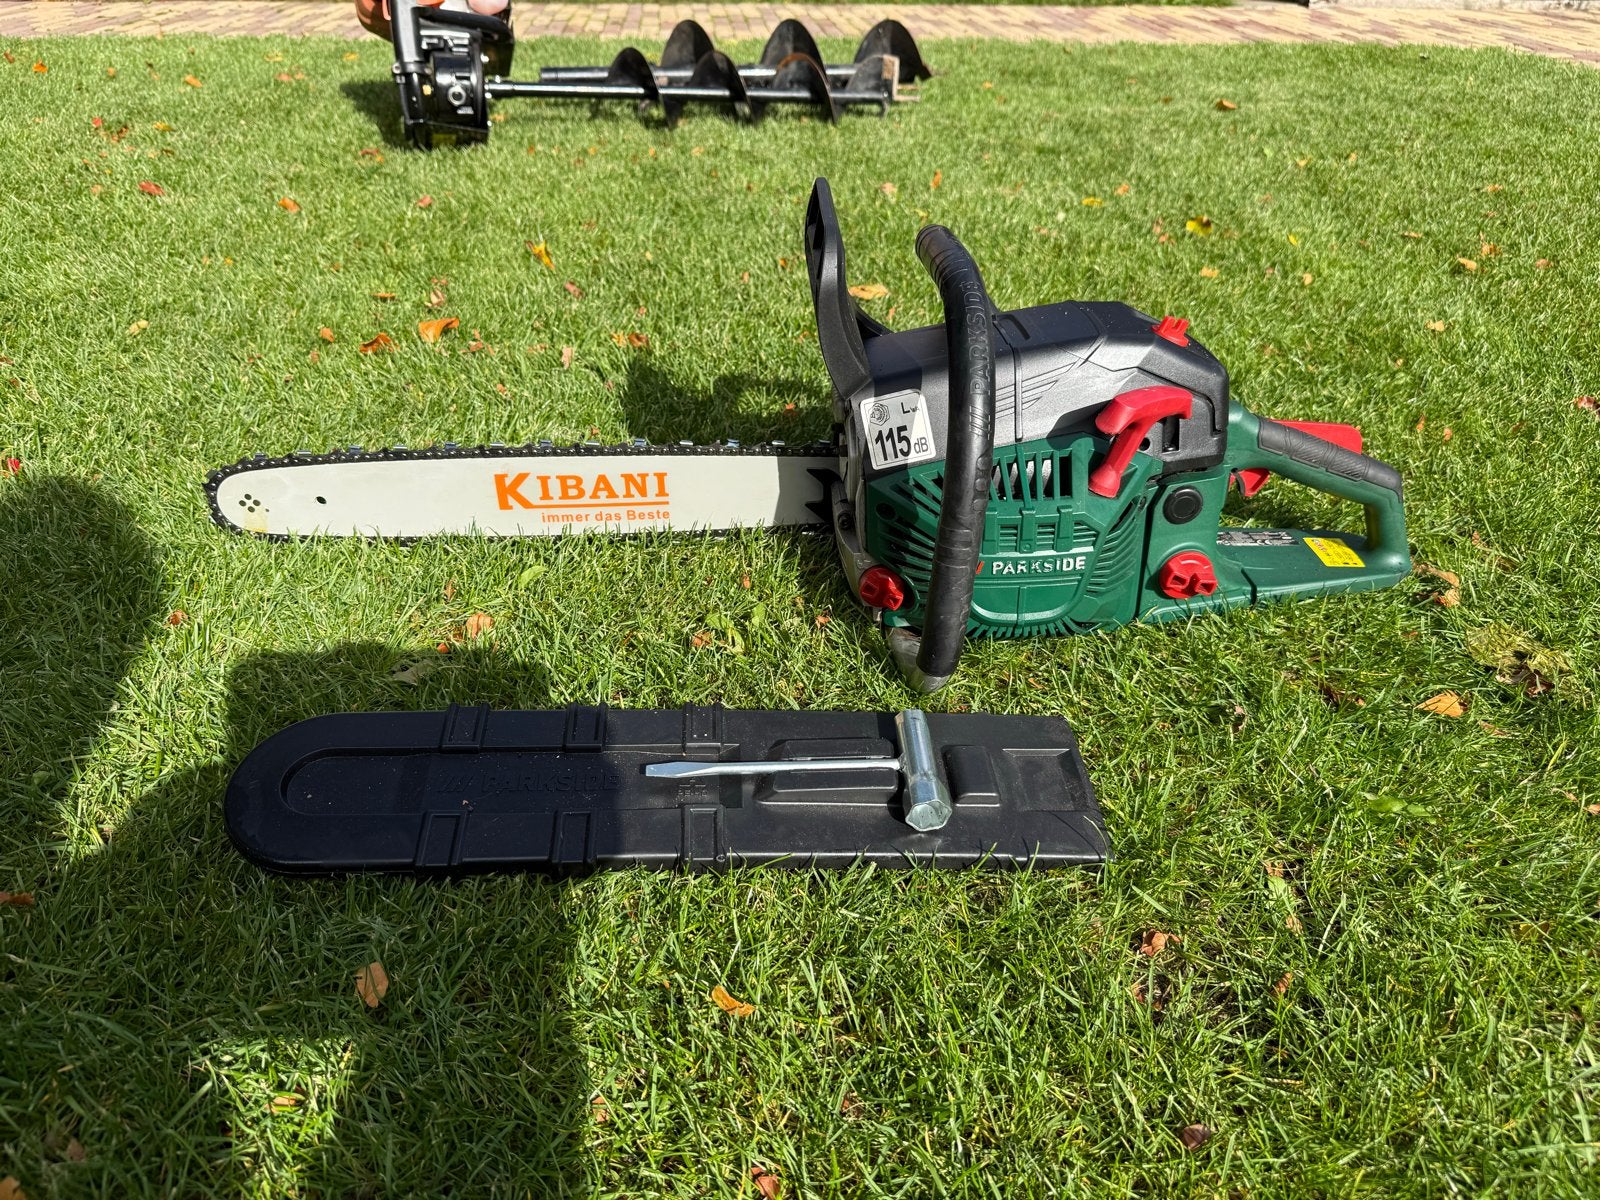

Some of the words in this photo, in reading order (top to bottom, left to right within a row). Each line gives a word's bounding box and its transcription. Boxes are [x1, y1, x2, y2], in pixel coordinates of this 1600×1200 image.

[875, 425, 911, 461] 115
[913, 436, 929, 454] dB
[494, 472, 670, 510] KIBANI
[541, 512, 590, 523] immer
[594, 511, 622, 522] das
[626, 509, 670, 521] Beste
[992, 556, 1086, 575] PARKSIDE
